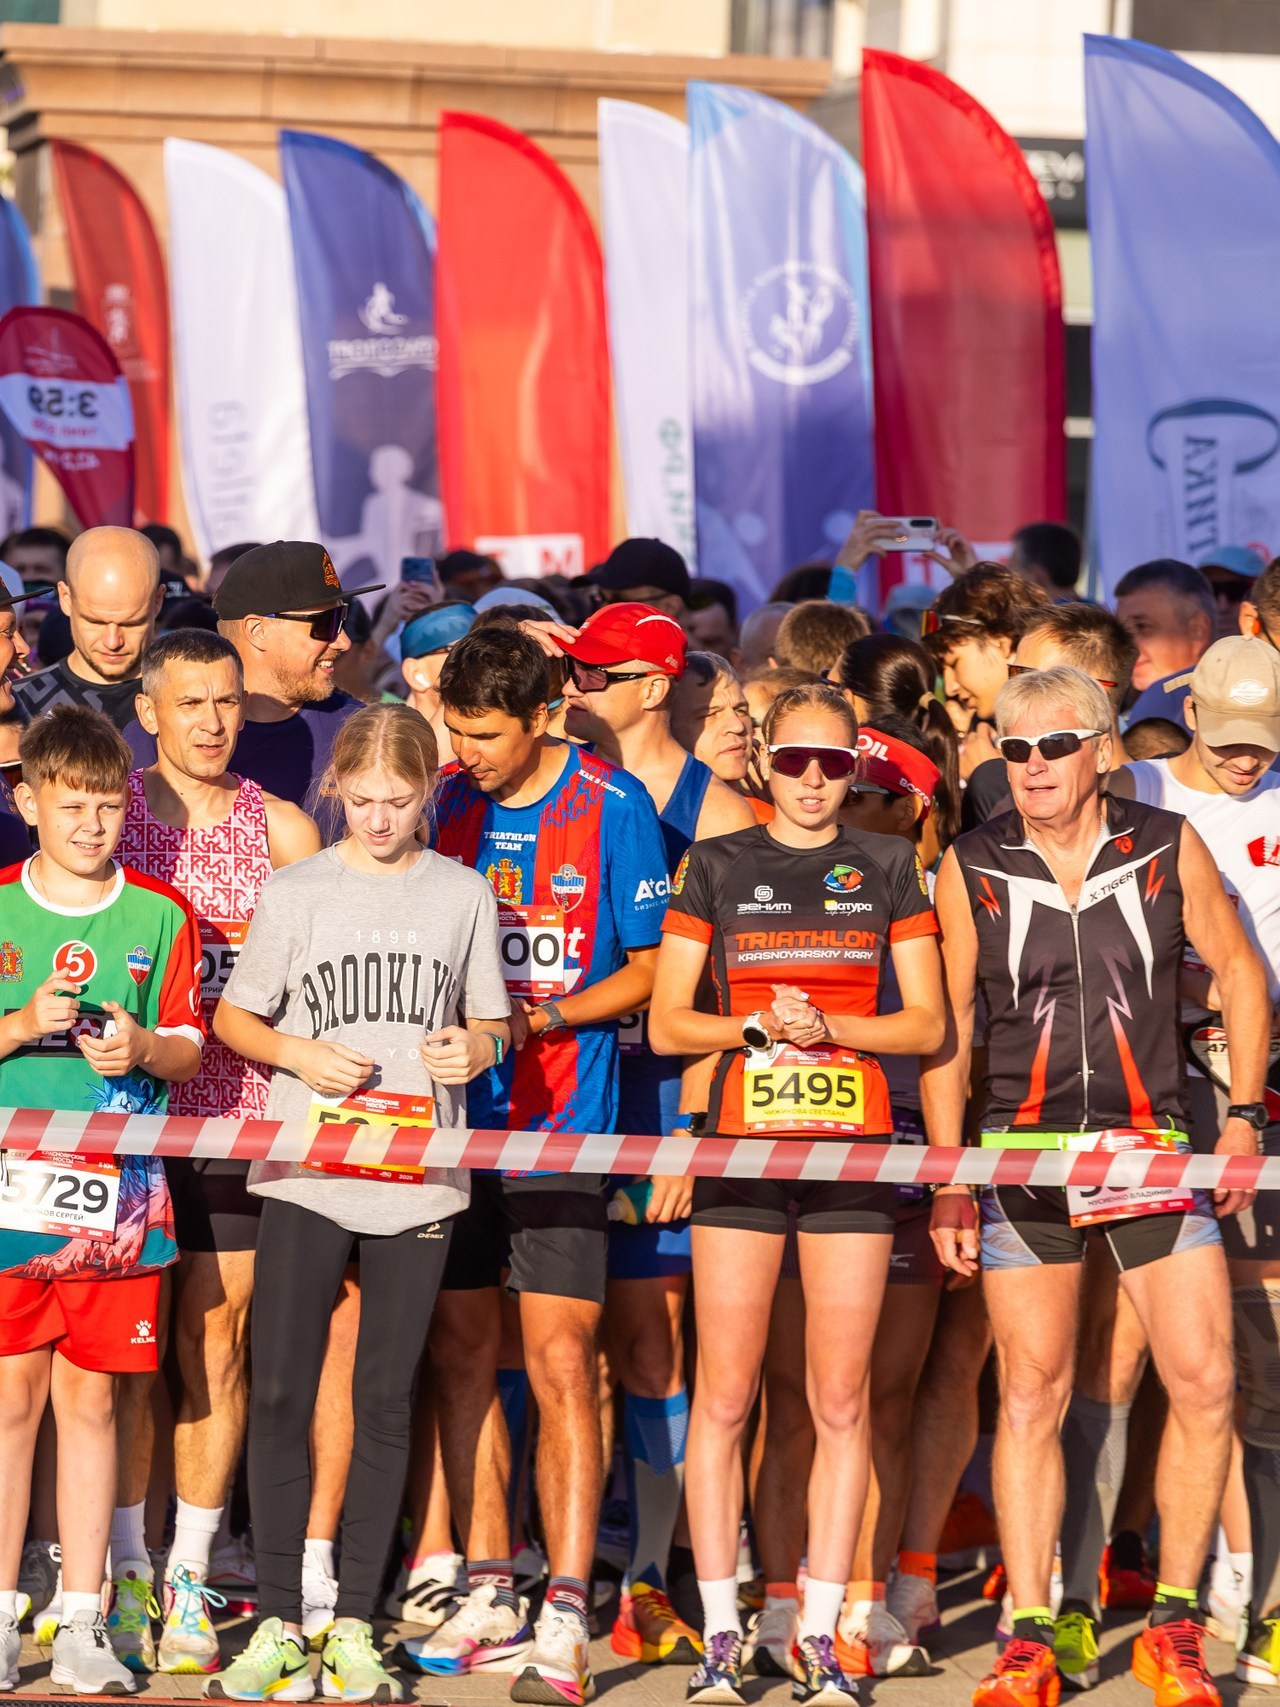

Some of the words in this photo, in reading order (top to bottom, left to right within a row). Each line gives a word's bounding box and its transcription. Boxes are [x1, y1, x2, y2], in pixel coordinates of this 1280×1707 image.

[483, 831, 537, 842] TRIATHLON
[495, 842, 522, 851] TEAM
[1089, 870, 1134, 903] X-TIGER
[354, 930, 417, 944] 1898
[735, 930, 878, 951] TRIATHLON
[738, 950, 841, 962] KRASNOYARSKIY
[844, 950, 874, 960] KRAY
[752, 1072, 856, 1108] 5495
[1, 1168, 109, 1214] 5729
[56, 1211, 84, 1221] СЕРГЕЙ
[416, 1232, 445, 1240] DEMIX
